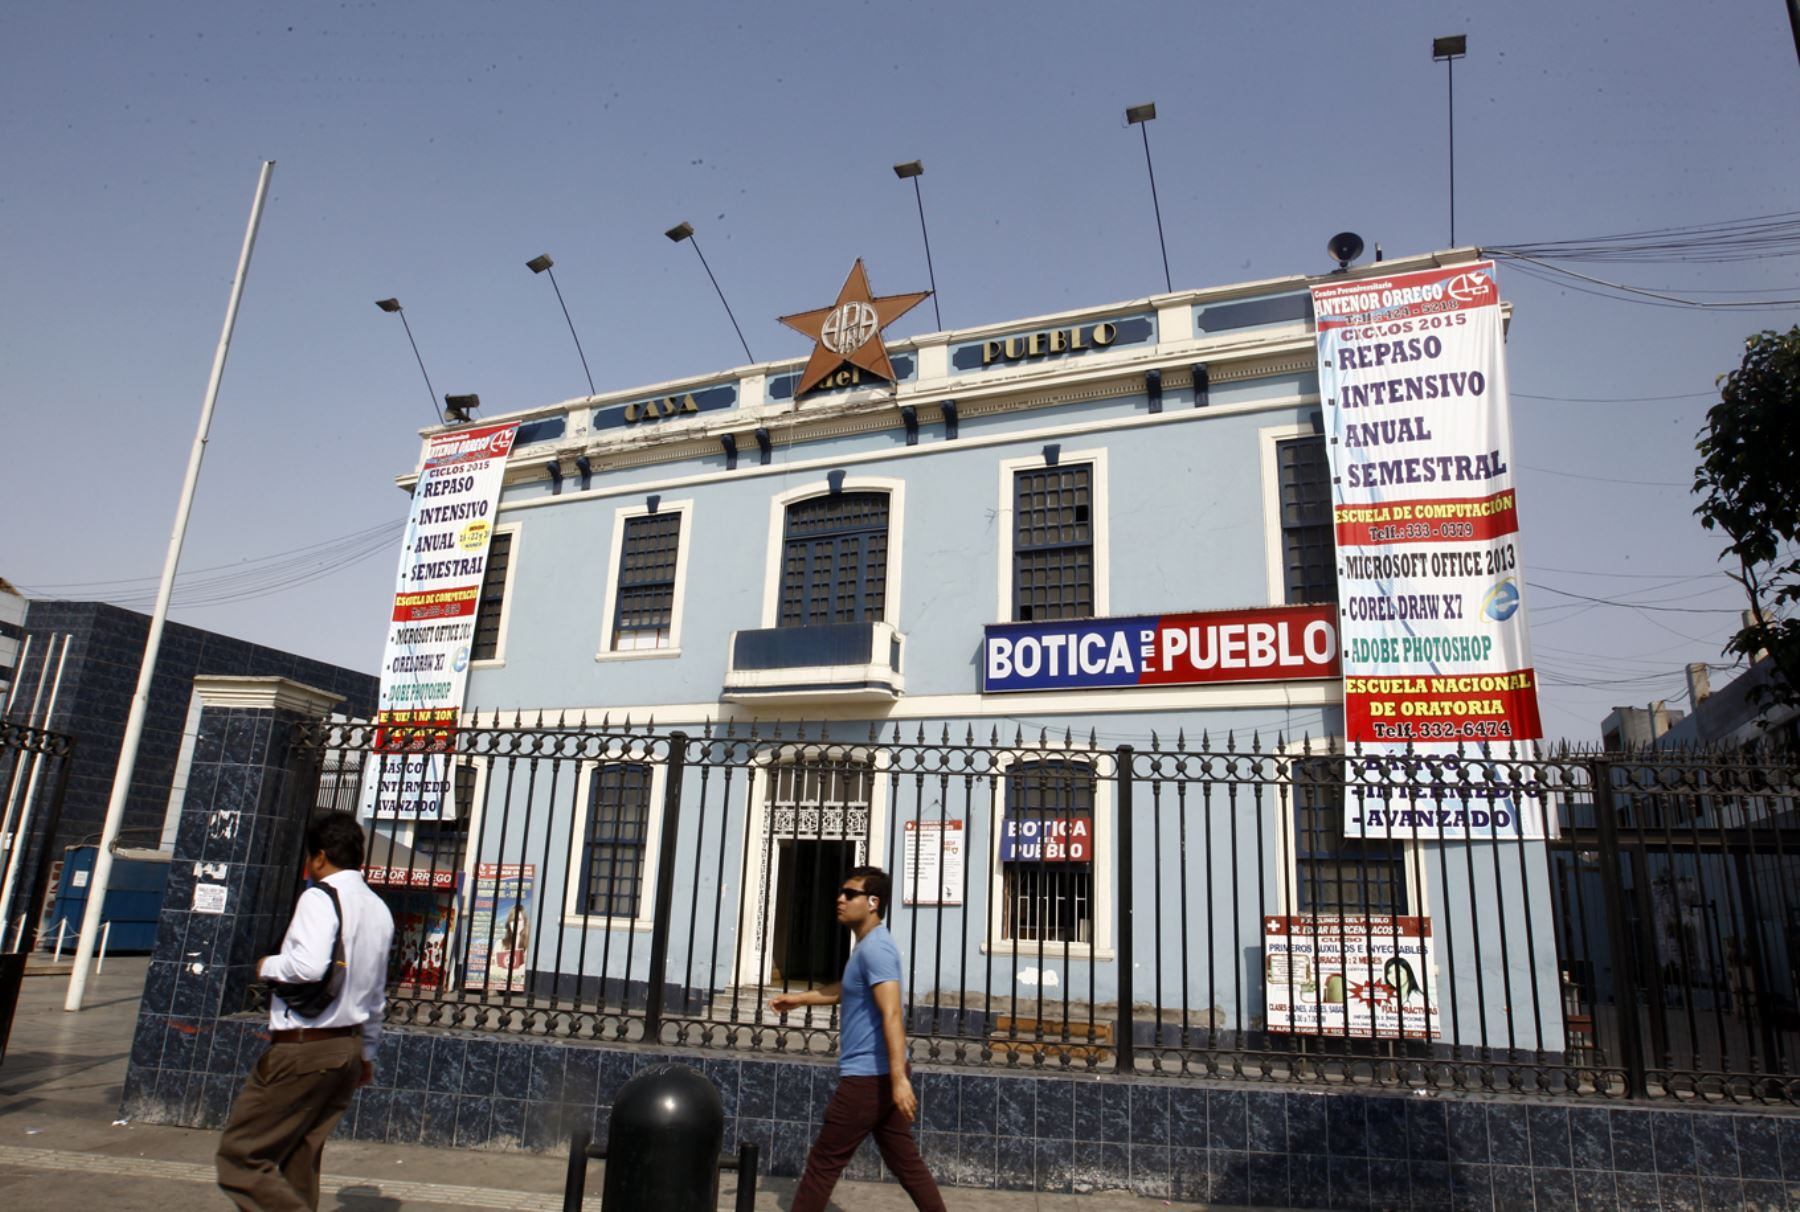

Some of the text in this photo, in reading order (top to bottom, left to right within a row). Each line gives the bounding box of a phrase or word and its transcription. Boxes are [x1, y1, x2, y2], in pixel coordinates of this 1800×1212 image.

[1314, 283, 1443, 316] ANTENOR ORREGO
[1341, 313, 1467, 341] CICLOS 2015
[983, 323, 1117, 364] PUEBLO
[1338, 335, 1442, 371] REPASO
[1341, 370, 1485, 409] INTENSIVO
[624, 393, 698, 421] CASA
[1345, 416, 1431, 448] ANUAL
[429, 460, 490, 478] CICLOS 2015
[1348, 450, 1507, 488] SEMESTRAL
[423, 475, 474, 499] REPASO
[418, 499, 489, 526] INTENSIVO
[1335, 495, 1513, 524] ESCUELA DE COMPUTACIÓN
[414, 532, 455, 554] ANUAL
[1407, 524, 1430, 538] 333
[1441, 523, 1473, 537] 0379
[1346, 544, 1515, 580] MICROSOFT OFFICE 2013
[1349, 594, 1463, 621] COREL DRAW X7
[988, 619, 1336, 679] BOTICA DEL PUEBLO
[1352, 635, 1492, 663] ADOBE PHOTOSHOP
[1346, 673, 1531, 694] ESCUELA NACIONAL
[1370, 699, 1505, 717] DE ORATORIA
[1374, 721, 1512, 738] Telf. 332-6474
[380, 799, 436, 812] VANZADO
[1008, 821, 1087, 837] BOTICA
[1367, 809, 1511, 828] AVANZADO
[1010, 843, 1082, 858] PUEBLO
[1371, 926, 1404, 935] ACOSA
[1316, 945, 1356, 953] UXILOS
[1366, 945, 1429, 955] NYECABLES
[1359, 957, 1382, 965] MEES
